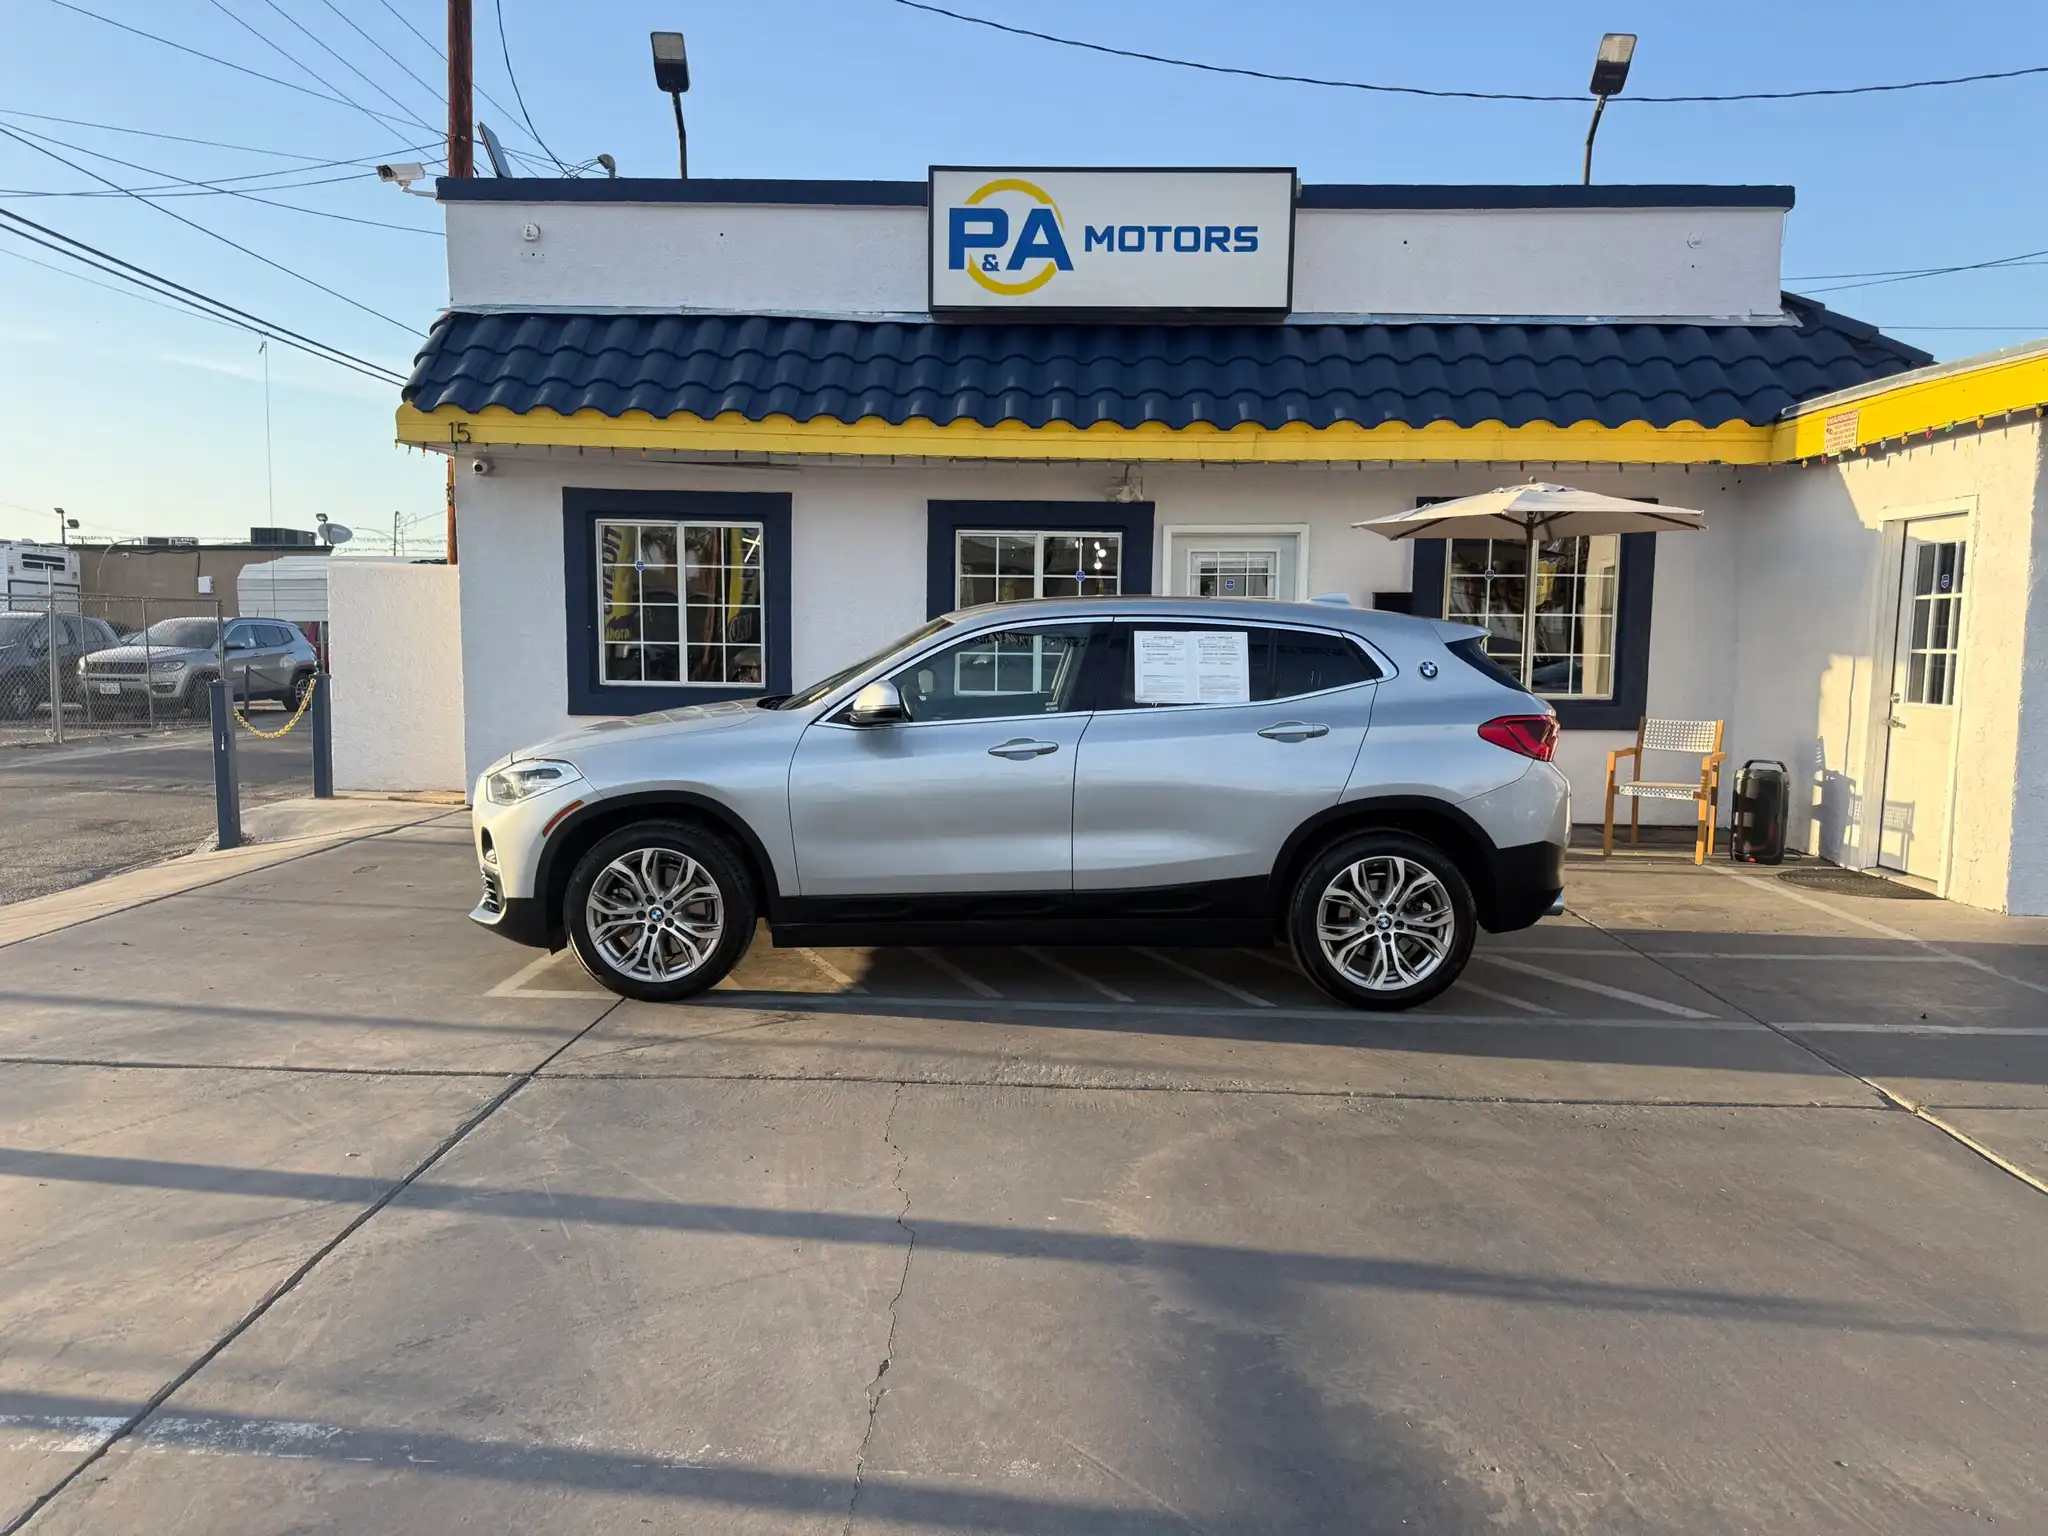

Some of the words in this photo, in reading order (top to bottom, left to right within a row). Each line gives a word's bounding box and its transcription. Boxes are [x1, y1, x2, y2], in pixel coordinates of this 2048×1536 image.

[948, 207, 1074, 272] P&A
[1084, 225, 1259, 253] MOTORS
[449, 421, 471, 444] 15
